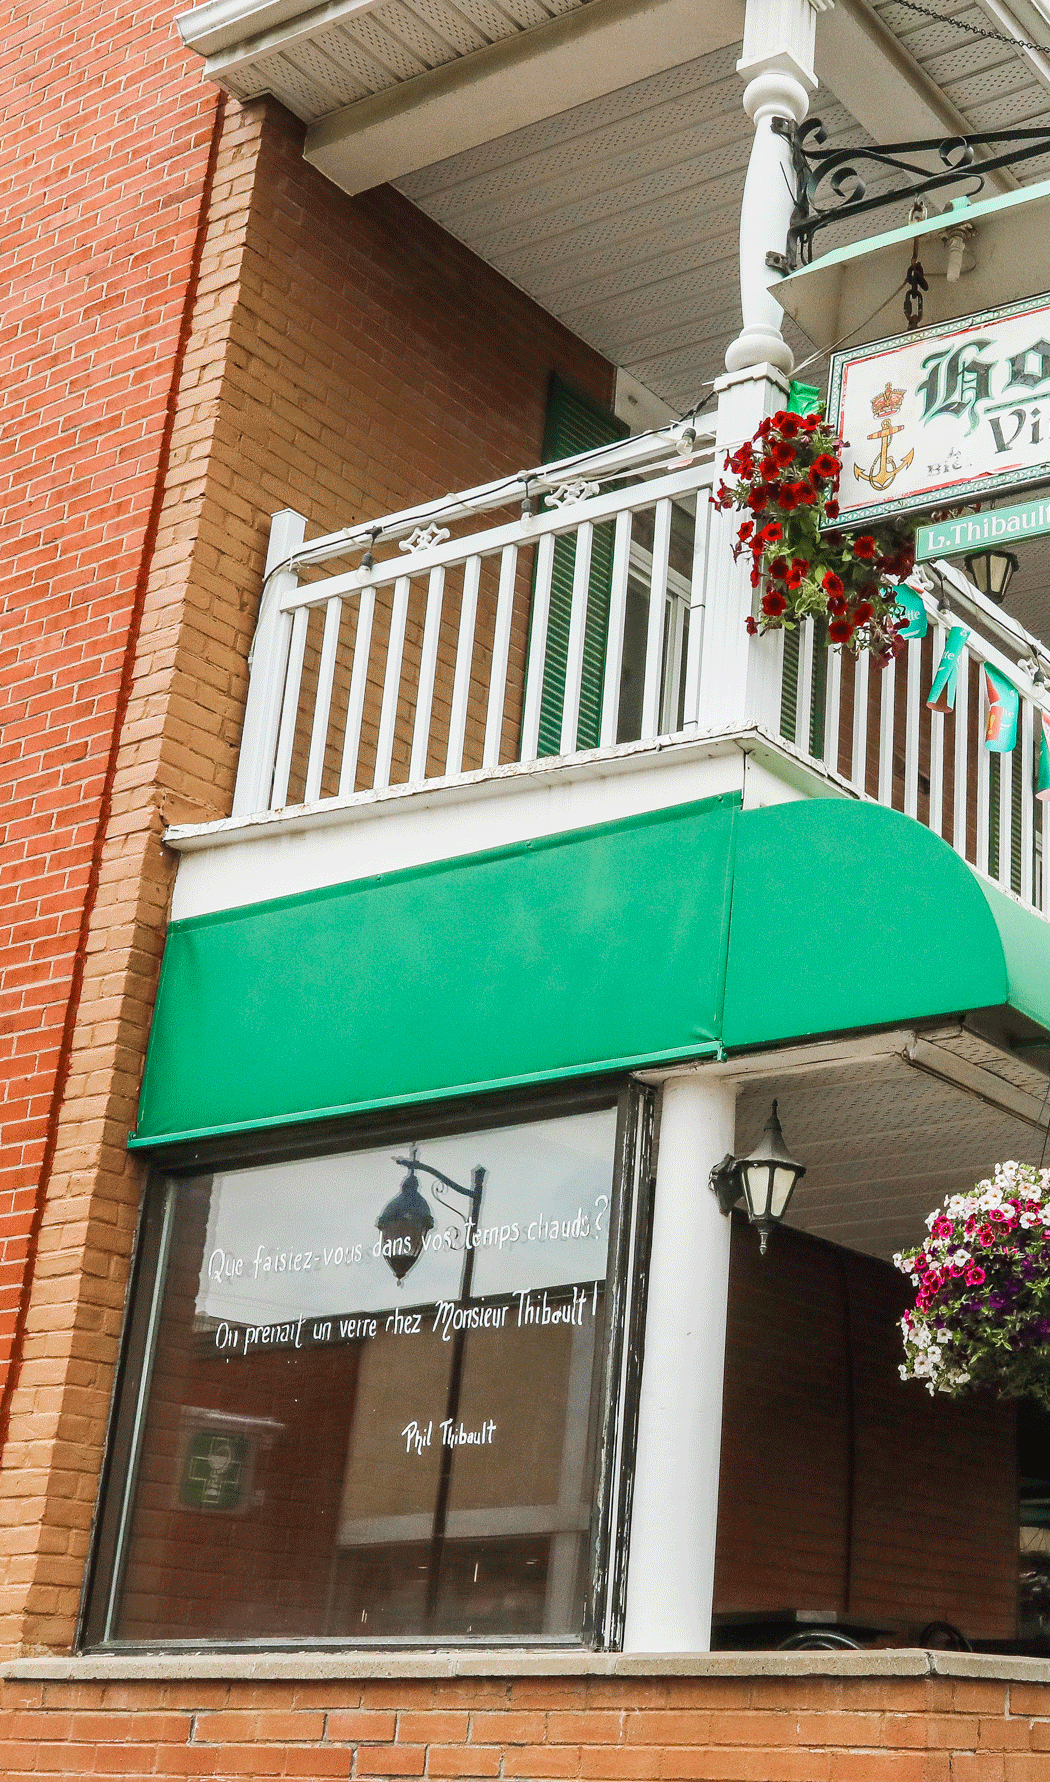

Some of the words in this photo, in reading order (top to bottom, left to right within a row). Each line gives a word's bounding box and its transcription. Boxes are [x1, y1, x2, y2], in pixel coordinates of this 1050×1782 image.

[208, 1247, 244, 1284] Que
[252, 1243, 362, 1280] faisiez-vous
[372, 1230, 412, 1259] dans
[420, 1230, 452, 1252] vos
[463, 1215, 520, 1251] temps
[215, 1321, 238, 1349] On
[242, 1312, 307, 1356] prenait
[312, 1320, 333, 1341] un
[339, 1317, 378, 1340] verre
[384, 1306, 422, 1336] chez
[432, 1298, 510, 1342] Monsieur
[401, 1420, 433, 1456] Phil
[438, 1417, 497, 1450] Thibault
